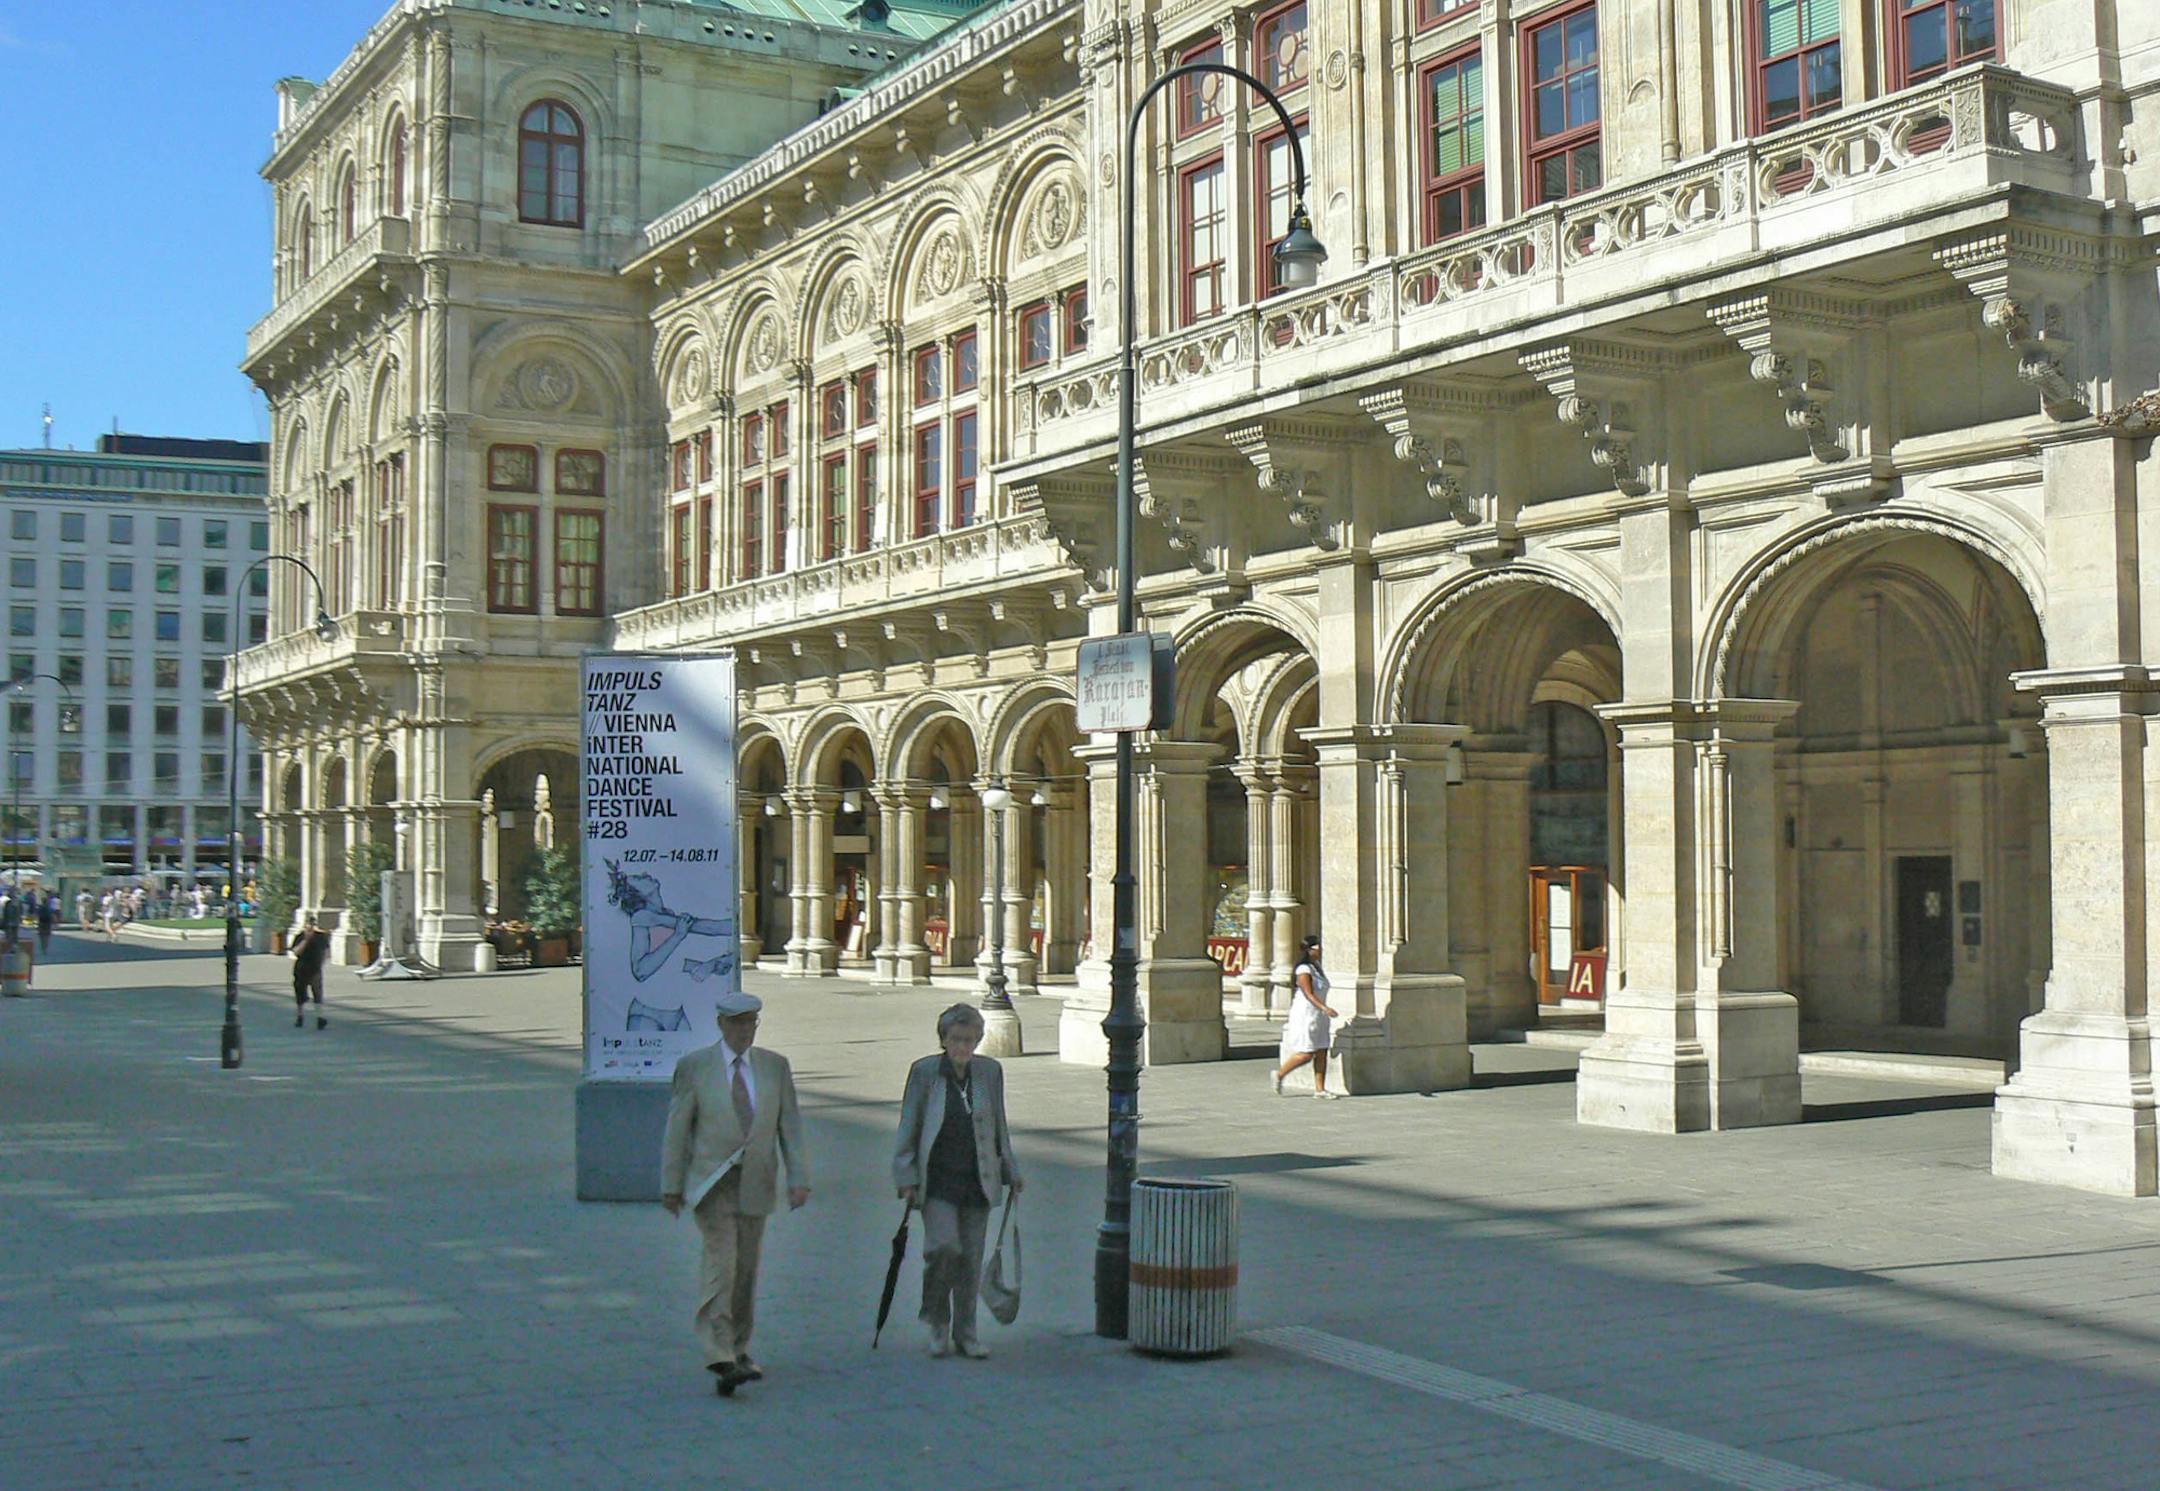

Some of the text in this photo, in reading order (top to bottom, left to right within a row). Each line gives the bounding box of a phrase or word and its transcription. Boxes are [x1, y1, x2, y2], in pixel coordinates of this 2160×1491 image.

[587, 671, 663, 691] IMPULS
[587, 693, 637, 712] TANZ
[587, 756, 684, 775] NATIONAL
[587, 777, 653, 797] DANCE
[587, 798, 678, 818] FESTIVAL
[587, 820, 628, 839] #28
